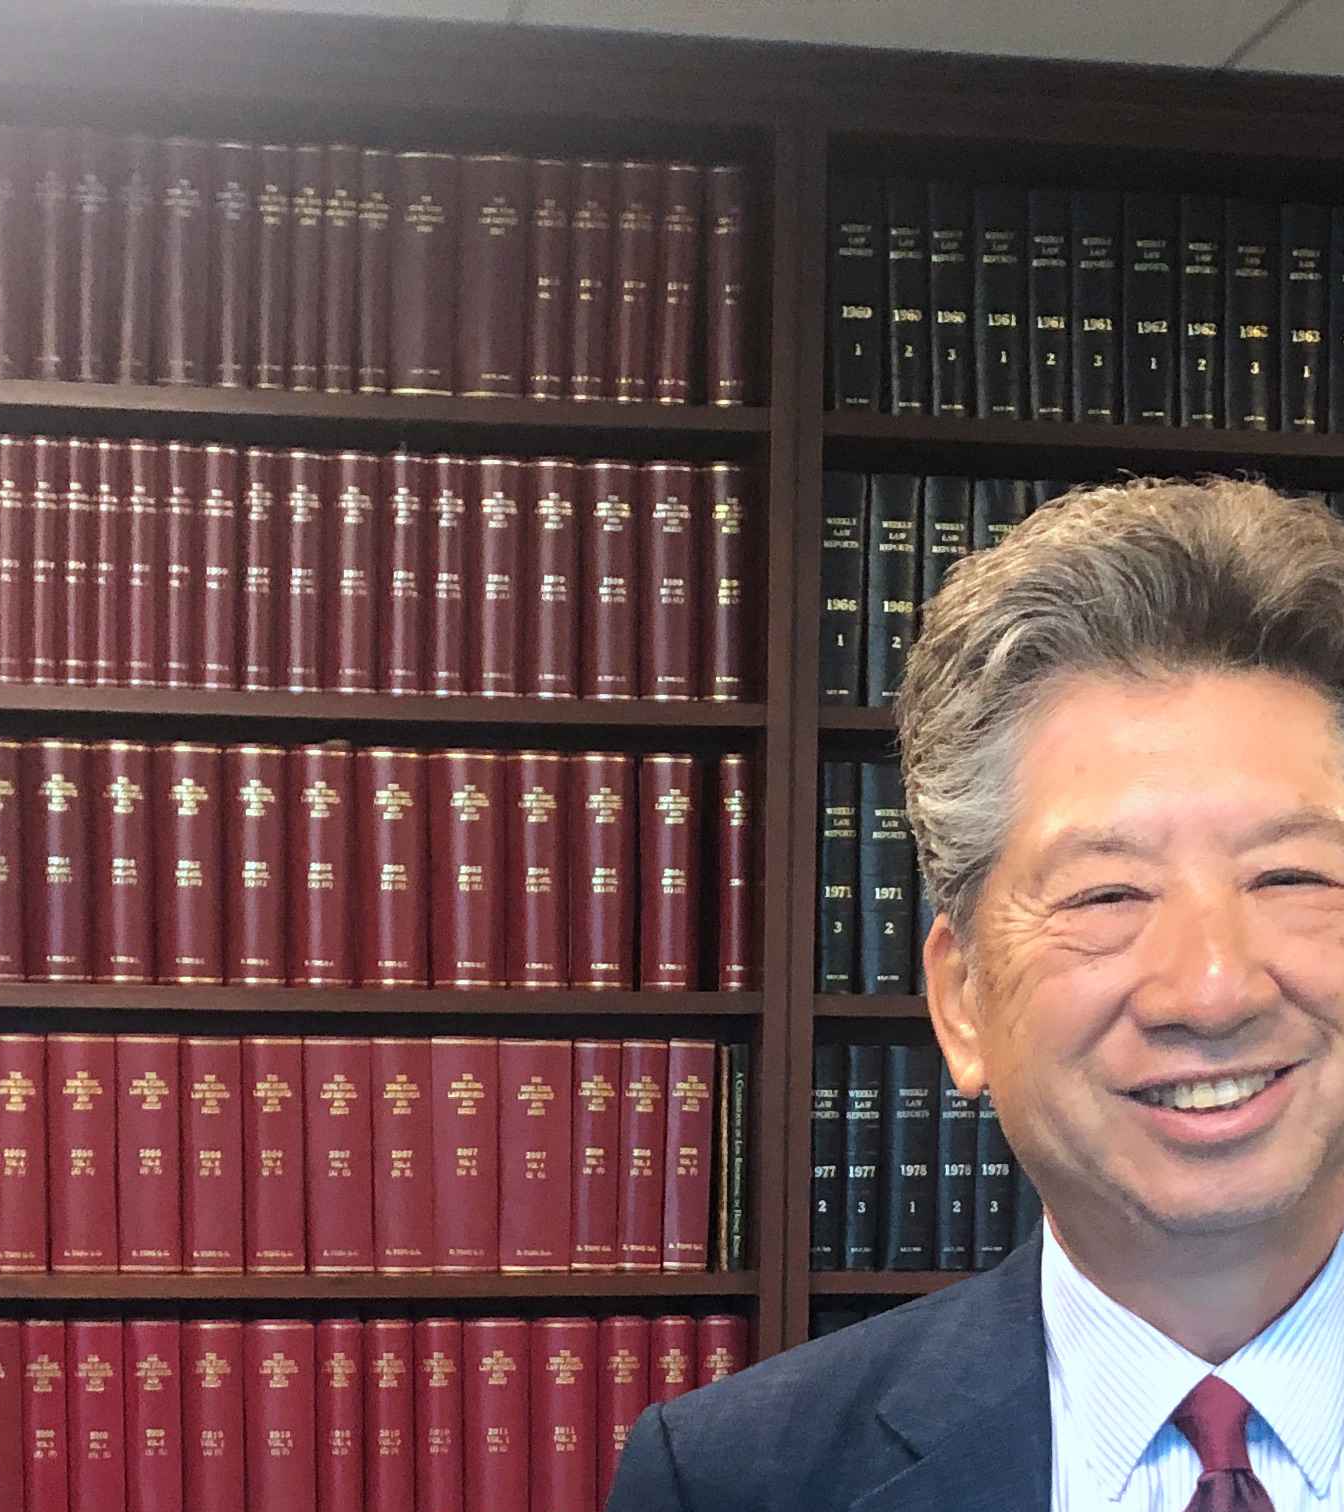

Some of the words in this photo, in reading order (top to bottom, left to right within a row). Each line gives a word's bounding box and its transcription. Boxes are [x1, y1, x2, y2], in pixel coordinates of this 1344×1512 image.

[1084, 318, 1112, 331] 1961
[1137, 321, 1168, 334] 1962
[1188, 323, 1217, 336] 1962
[1292, 330, 1321, 343] 1963
[855, 344, 861, 355] 1
[905, 345, 913, 357] 2
[948, 349, 956, 360] 3
[1001, 351, 1006, 363] 1
[1046, 353, 1055, 365] 2
[1094, 355, 1102, 366] 3
[1151, 357, 1156, 369] 1
[1198, 359, 1206, 371] 2
[1250, 362, 1259, 374] 3
[1304, 366, 1310, 378] 1
[837, 634, 844, 646] 1
[892, 637, 901, 648] 2
[825, 886, 852, 898] 1971
[875, 887, 903, 900] 1971
[833, 922, 842, 933] 3
[884, 922, 894, 934] 2
[848, 1165, 876, 1178] 1977
[818, 1201, 827, 1212] 2
[857, 1201, 866, 1213] 3
[910, 1201, 916, 1213] 1
[952, 1201, 961, 1213] 2
[990, 1201, 998, 1212] 3
